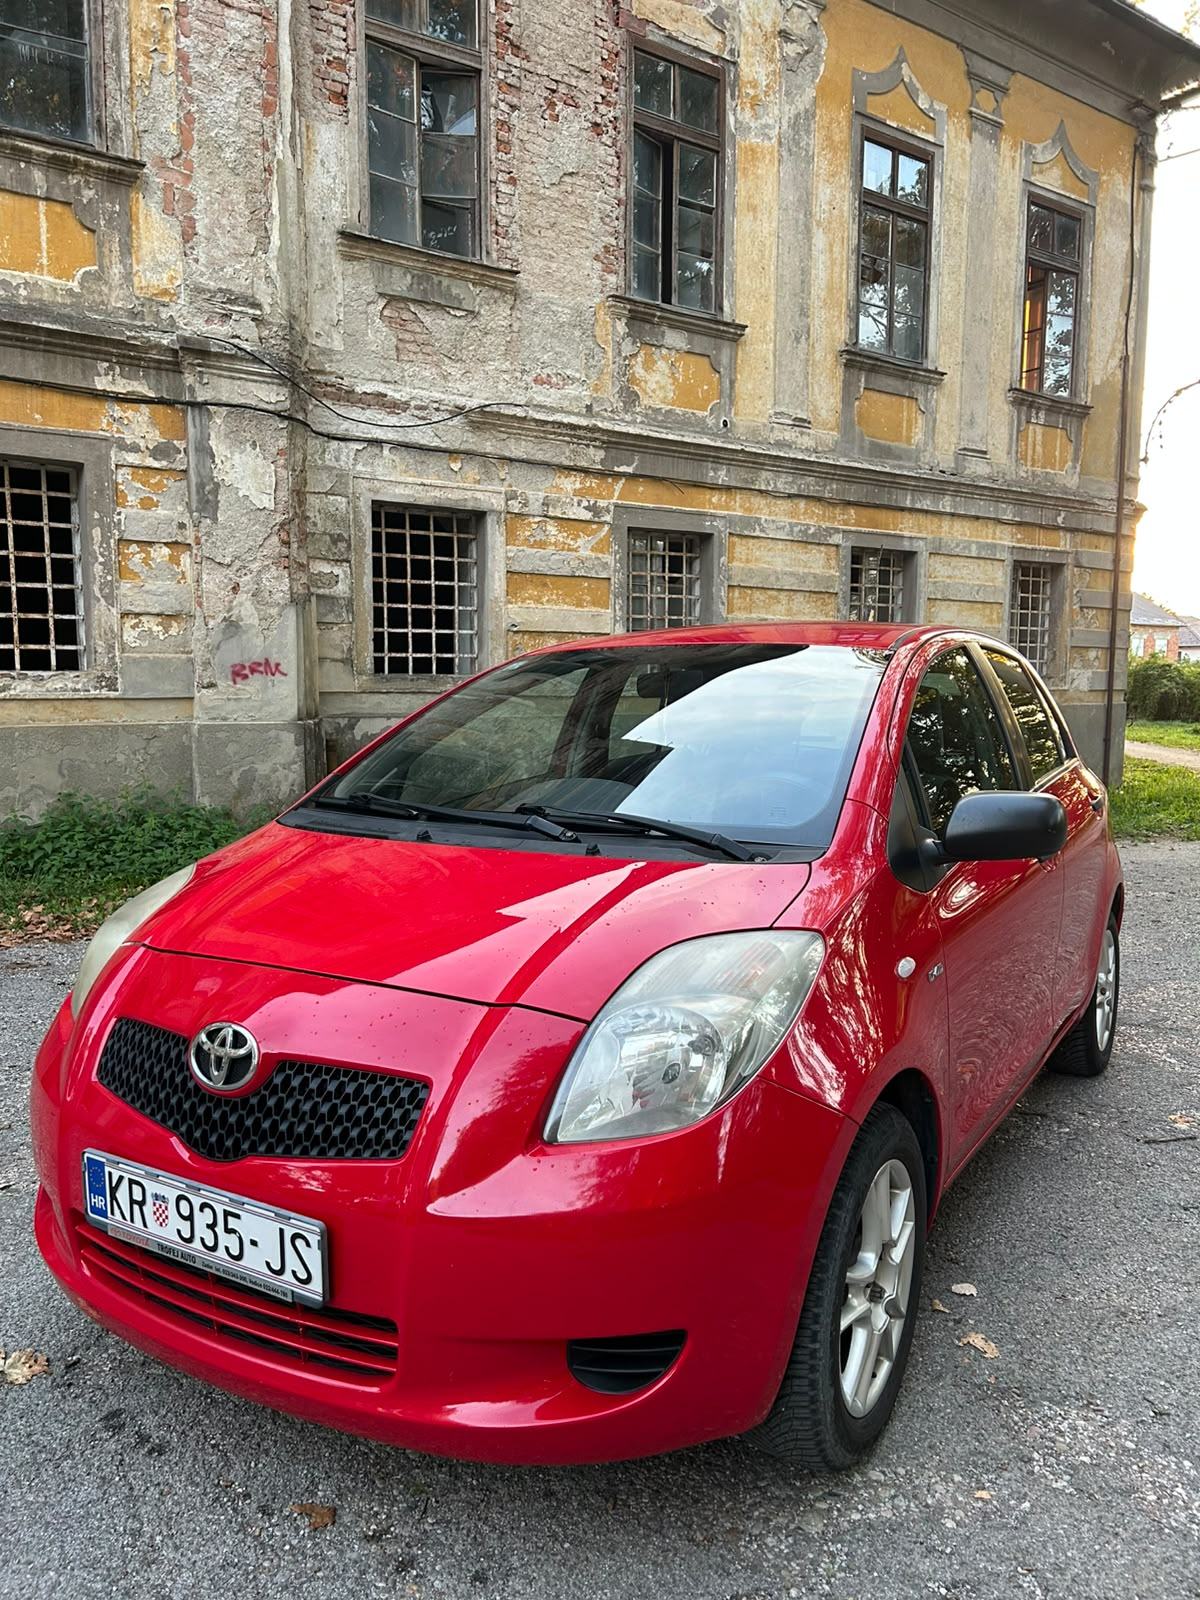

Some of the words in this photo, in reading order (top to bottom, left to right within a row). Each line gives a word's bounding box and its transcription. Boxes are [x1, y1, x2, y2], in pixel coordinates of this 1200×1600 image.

[91, 1193, 106, 1211] HR
[108, 1171, 148, 1229] KR
[176, 1194, 312, 1285] 935-JS
[181, 1251, 197, 1264] AUTO
